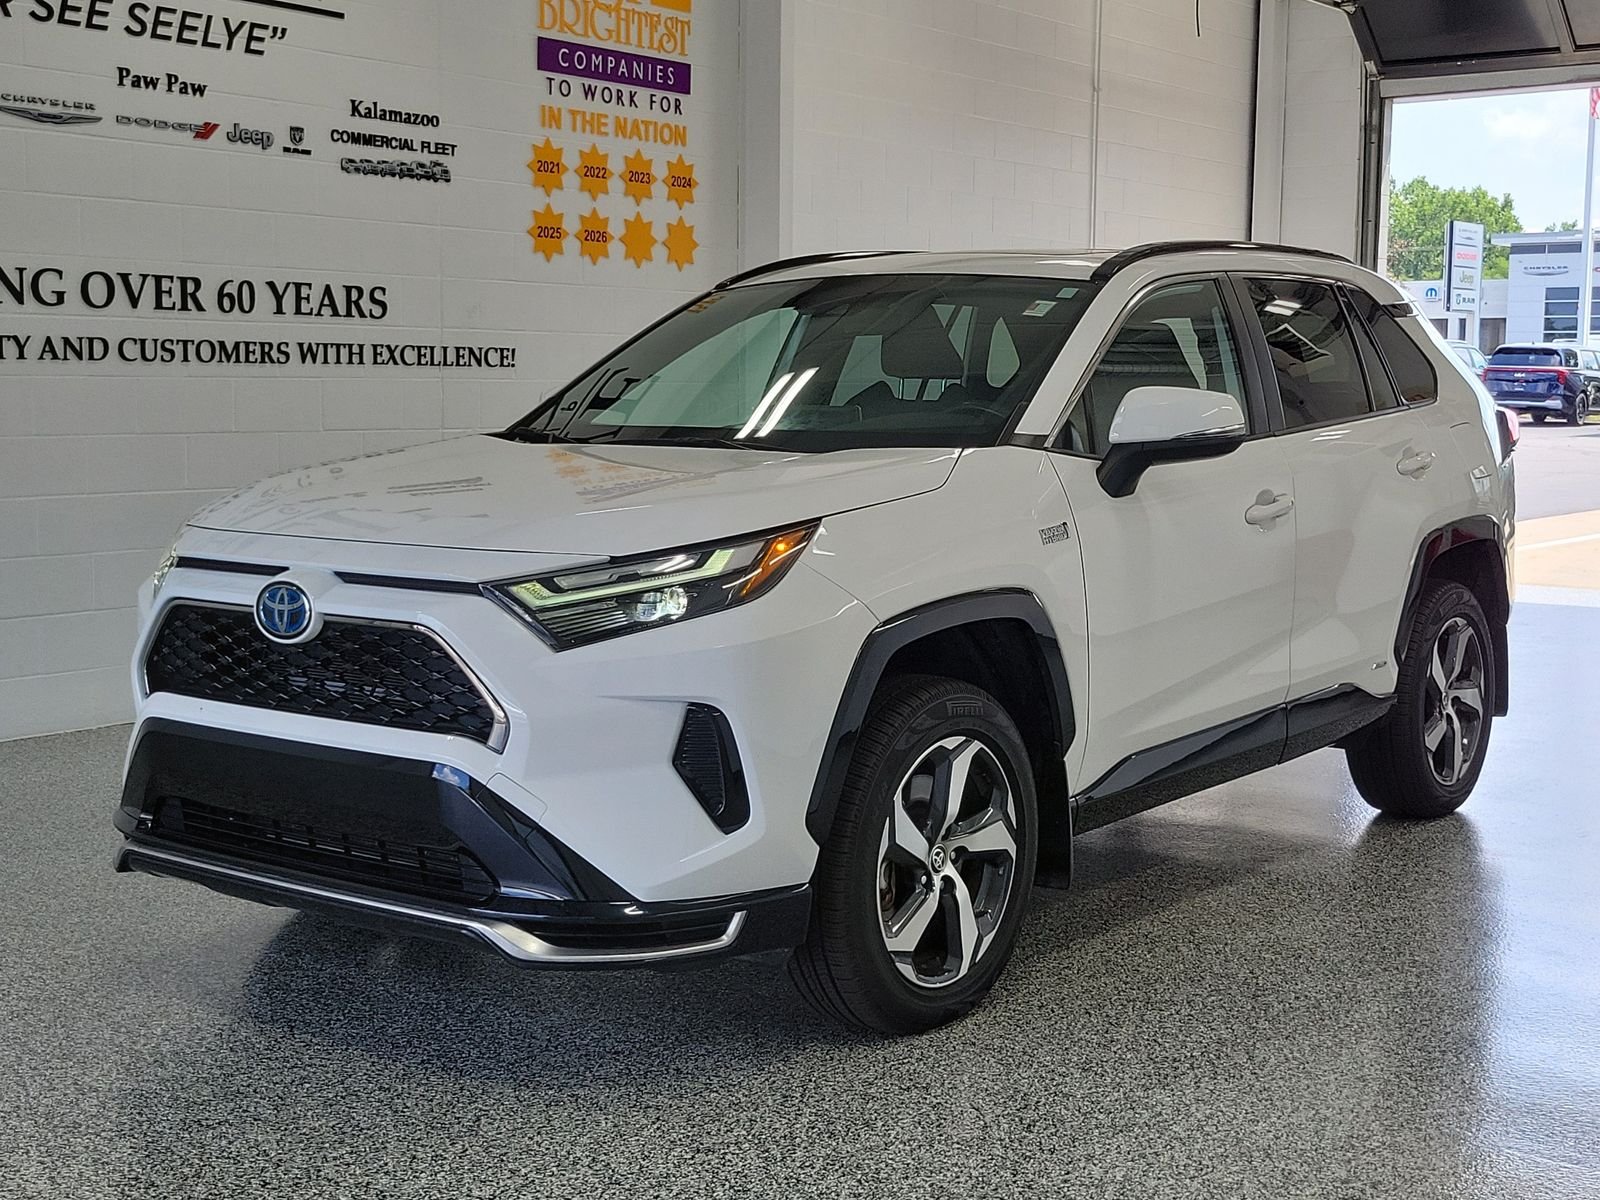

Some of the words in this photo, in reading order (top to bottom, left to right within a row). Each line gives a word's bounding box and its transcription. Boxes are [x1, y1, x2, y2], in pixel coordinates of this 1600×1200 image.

[537, 0, 691, 57] BRIGHTEST
[558, 48, 675, 85] COMPANIES
[116, 66, 160, 91] Paw
[165, 72, 208, 98] Paw
[1, 93, 96, 110] CHRYSLER
[546, 77, 572, 97] TO
[581, 82, 639, 108] WORK
[650, 94, 683, 116] FOR
[116, 115, 206, 133] DODGE
[349, 99, 440, 127] Kalamazoo
[540, 104, 562, 130] IN
[568, 108, 610, 137] THE
[614, 115, 688, 148] NATION
[226, 122, 275, 150] Jeep
[330, 129, 418, 152] COMMERCIAL
[421, 140, 458, 157] FLEET
[536, 160, 561, 174] 2021
[583, 165, 607, 180] 2022
[628, 170, 651, 185] 2023
[671, 175, 692, 189] 2024
[536, 225, 562, 240] 2025
[583, 229, 608, 244] 2026
[80, 270, 206, 313] OVER
[217, 279, 256, 315] 60
[265, 280, 388, 320] YEARS
[37, 335, 110, 362] AND
[117, 337, 291, 365] CUSTOMERS
[297, 342, 365, 366] WITH
[371, 344, 516, 368] EXCELLENCE!
